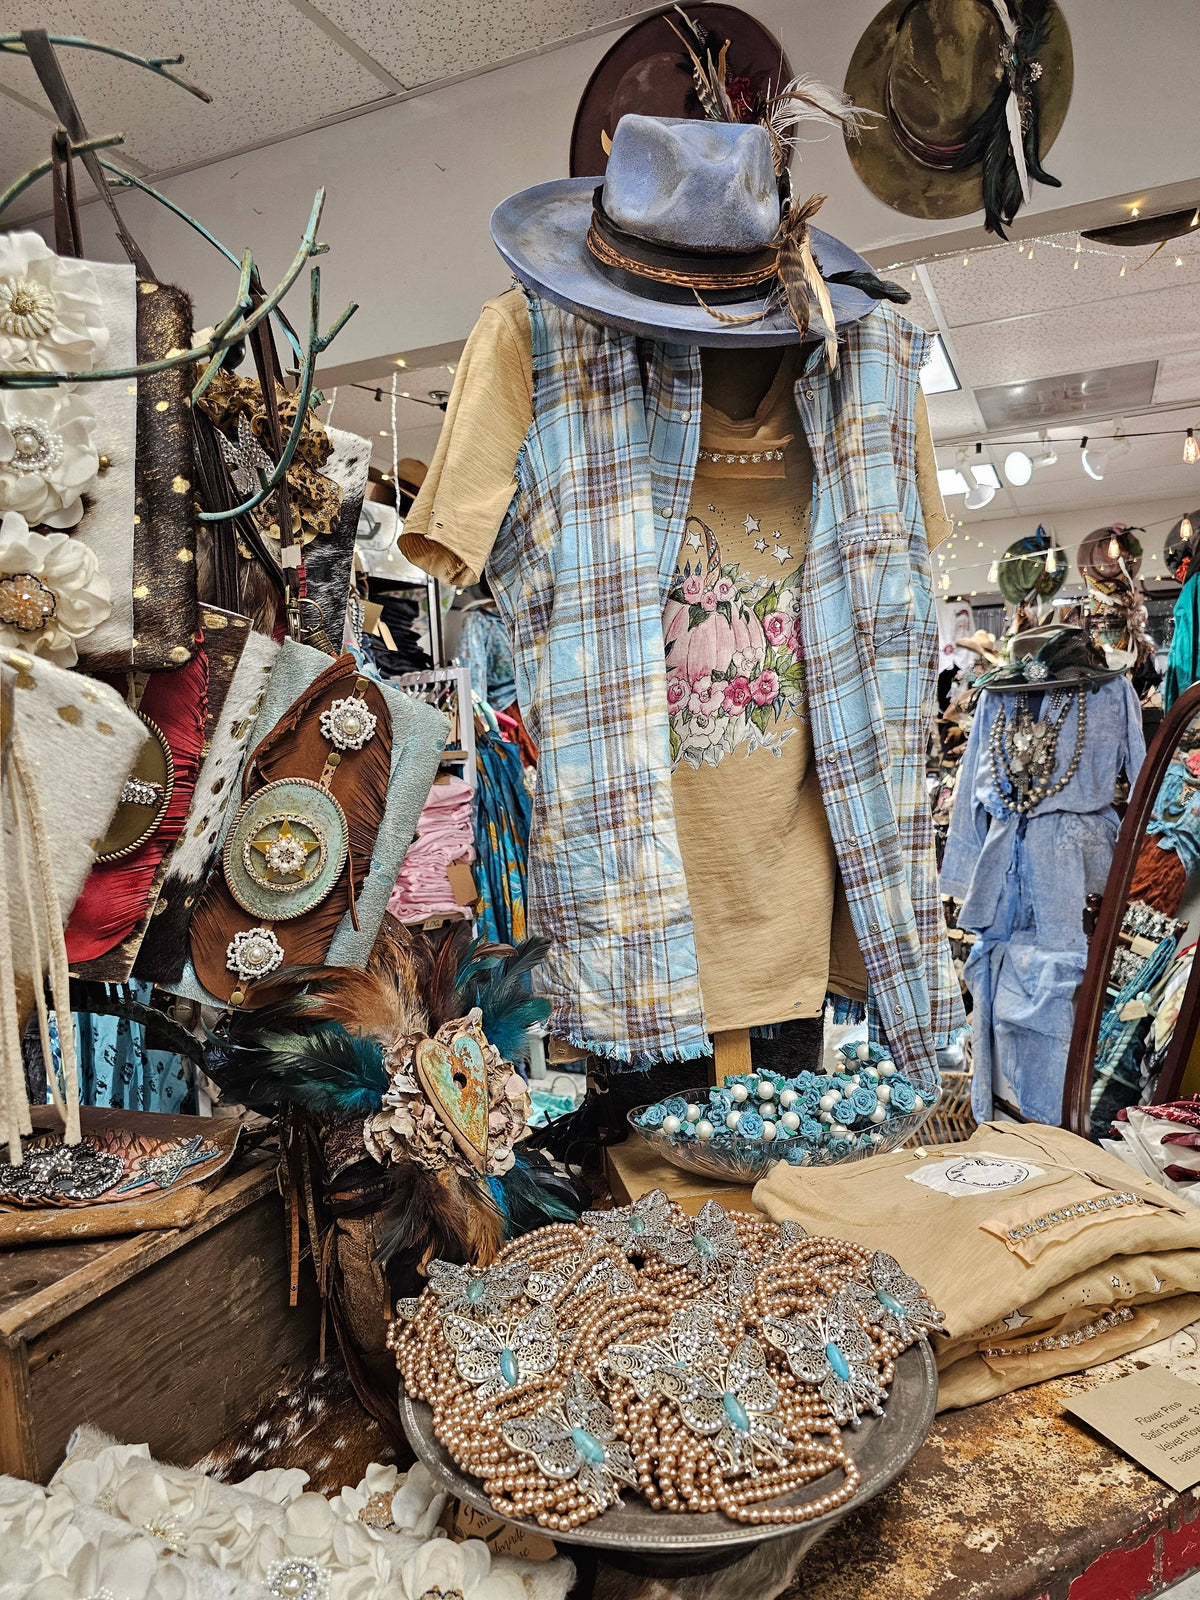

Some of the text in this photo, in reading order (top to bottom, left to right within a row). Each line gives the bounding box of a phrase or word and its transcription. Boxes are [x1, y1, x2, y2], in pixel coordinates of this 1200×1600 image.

[1135, 1402, 1182, 1425] Flower Pins
[1141, 1403, 1200, 1440] Satin Flower $1
[1155, 1425, 1200, 1451] Velvet Flow
